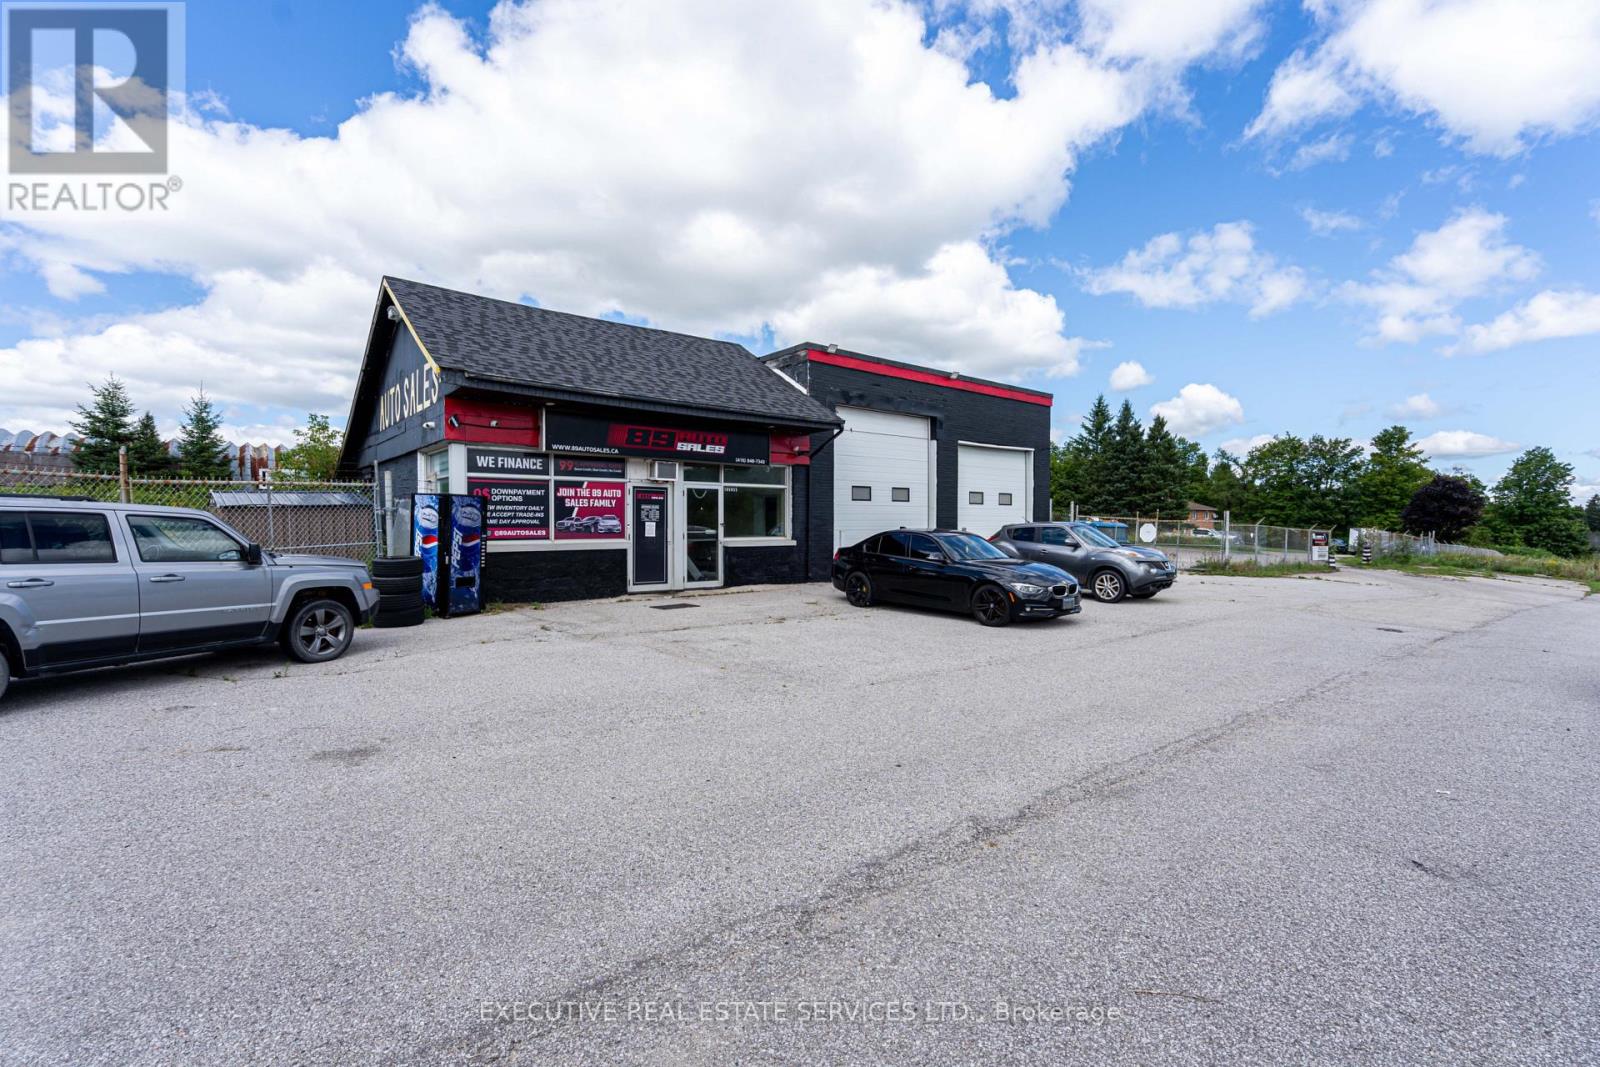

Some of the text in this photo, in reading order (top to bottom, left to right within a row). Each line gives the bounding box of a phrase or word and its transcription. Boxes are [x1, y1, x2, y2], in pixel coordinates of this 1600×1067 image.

[379, 363, 441, 432] AUTO SALES
[625, 427, 729, 449] 89 AUTO
[551, 443, 620, 454] WWW.89AUTOSALES.CA
[677, 441, 726, 454] SALES
[476, 455, 543, 470] WE FINANCE
[491, 488, 545, 496] DOWNPAYMENT
[557, 487, 575, 497] JOIN
[576, 488, 590, 498] THE
[603, 489, 622, 498] AUTO
[565, 498, 616, 508] SALES FAMILY
[414, 527, 423, 557] EPSI
[451, 527, 463, 568] PEPSI
